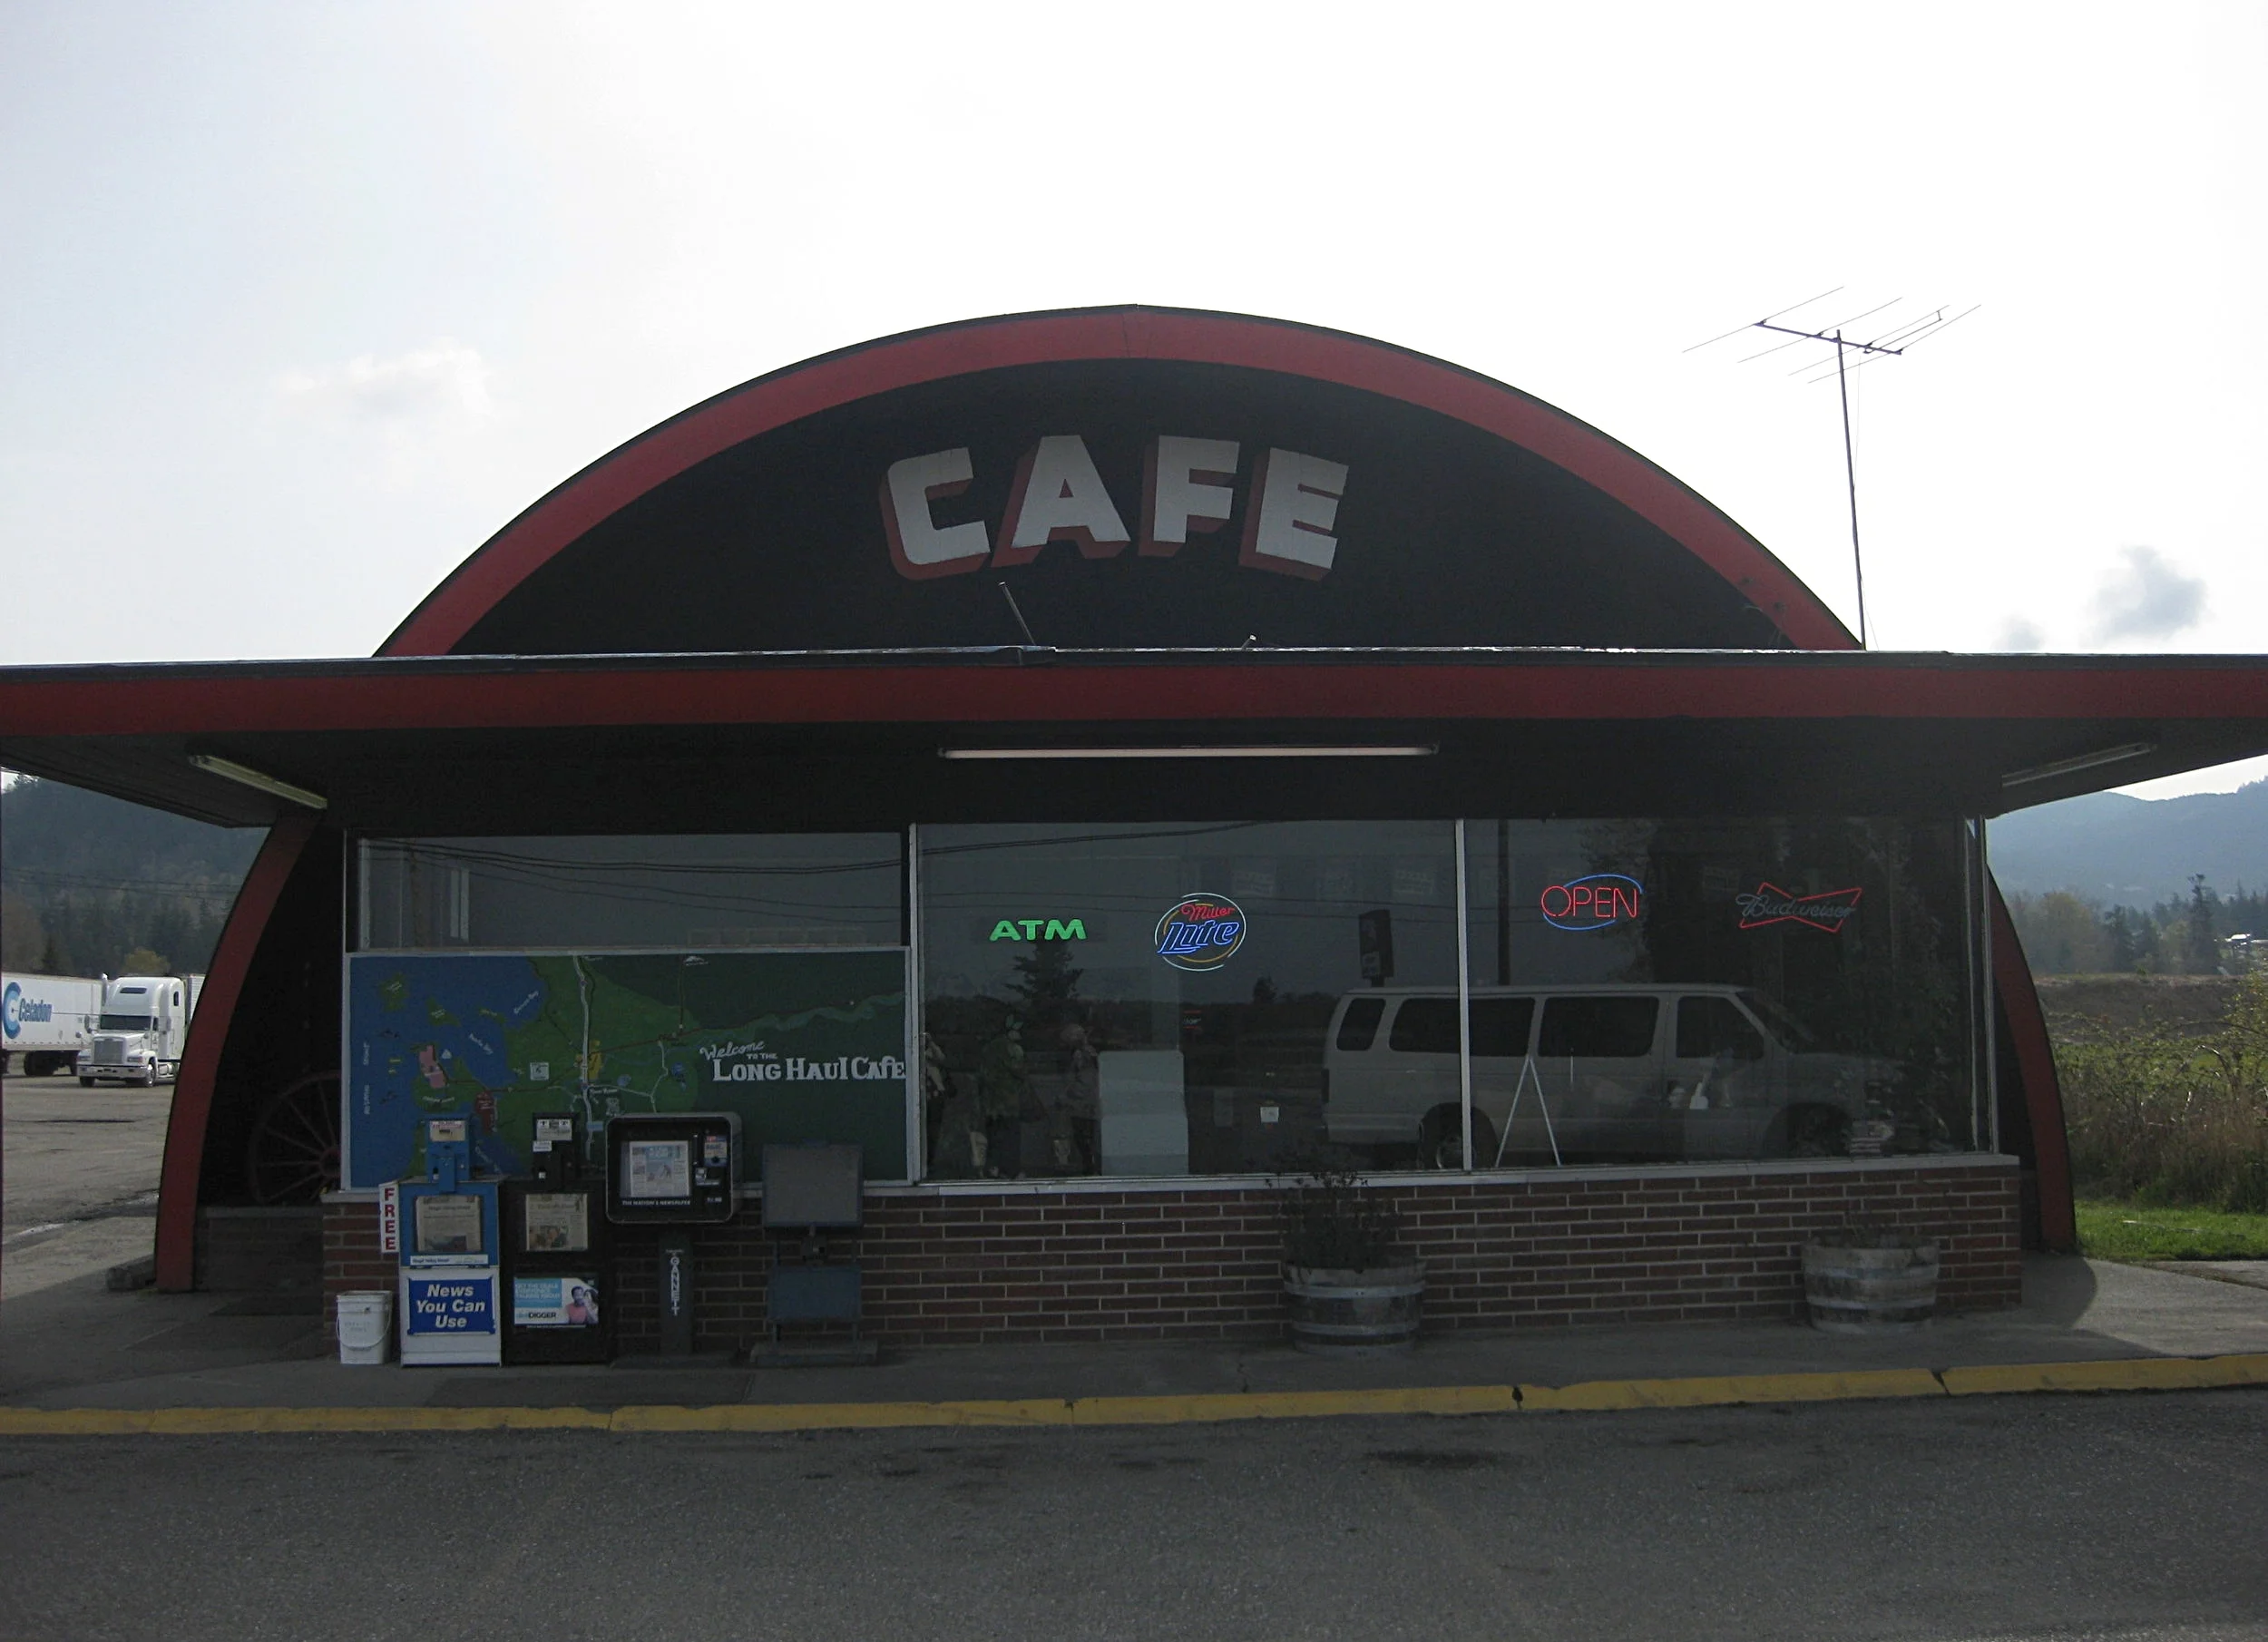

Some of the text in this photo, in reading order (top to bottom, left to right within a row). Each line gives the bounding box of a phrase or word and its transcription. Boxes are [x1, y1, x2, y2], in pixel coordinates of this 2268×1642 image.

[879, 435, 1350, 581] CAFE
[1180, 904, 1236, 921] Miller
[1540, 885, 1638, 918] OPEN
[1735, 893, 1857, 919] Budweiser
[989, 918, 1088, 941] ATM
[1156, 919, 1240, 954] Lite
[19, 998, 53, 1022] Celadon
[699, 1041, 766, 1060] Welcome
[384, 1188, 396, 1252] FREE
[427, 1284, 474, 1297] News
[670, 1256, 680, 1316] GANNETT
[415, 1298, 485, 1314] You Can
[435, 1315, 467, 1328] Use
